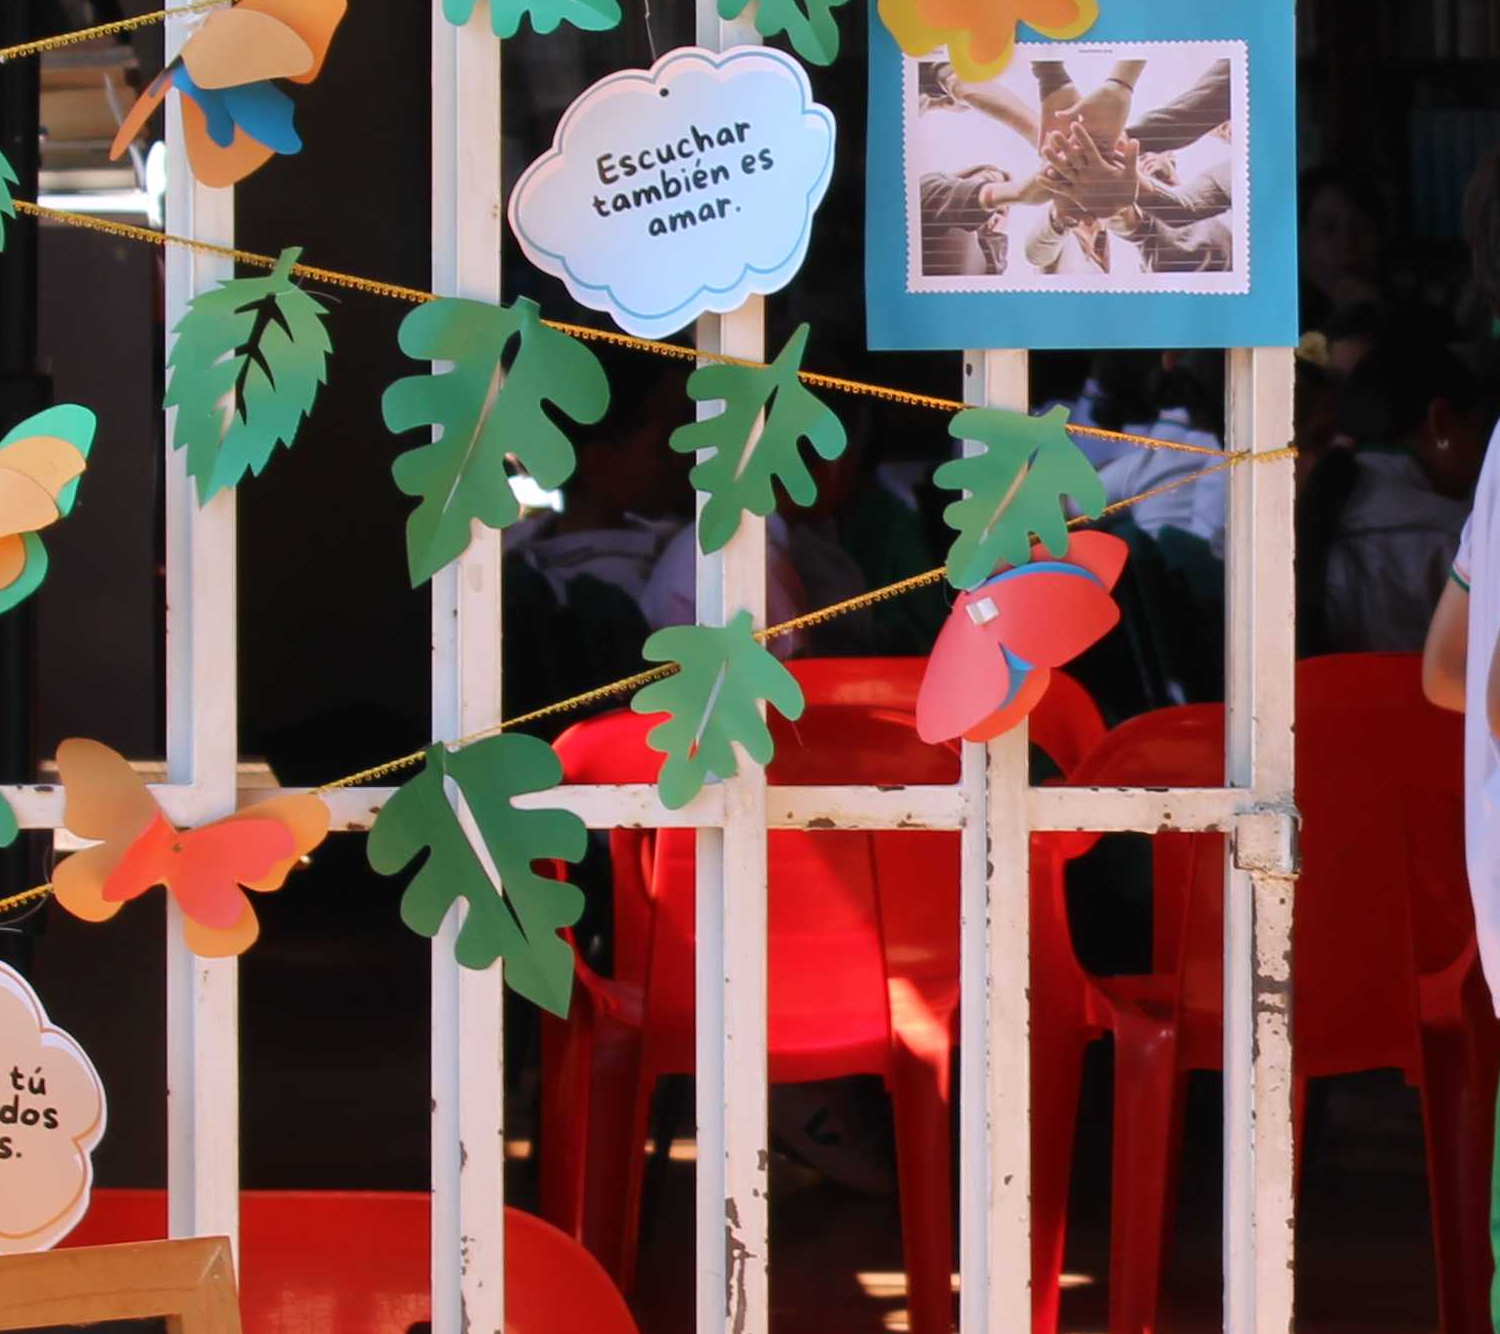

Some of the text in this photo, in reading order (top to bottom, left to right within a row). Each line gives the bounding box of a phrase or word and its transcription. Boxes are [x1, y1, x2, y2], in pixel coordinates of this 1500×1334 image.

[596, 121, 750, 185] Escuchar
[593, 147, 773, 217] también es
[648, 197, 741, 237] amar.
[10, 1066, 46, 1095] tú
